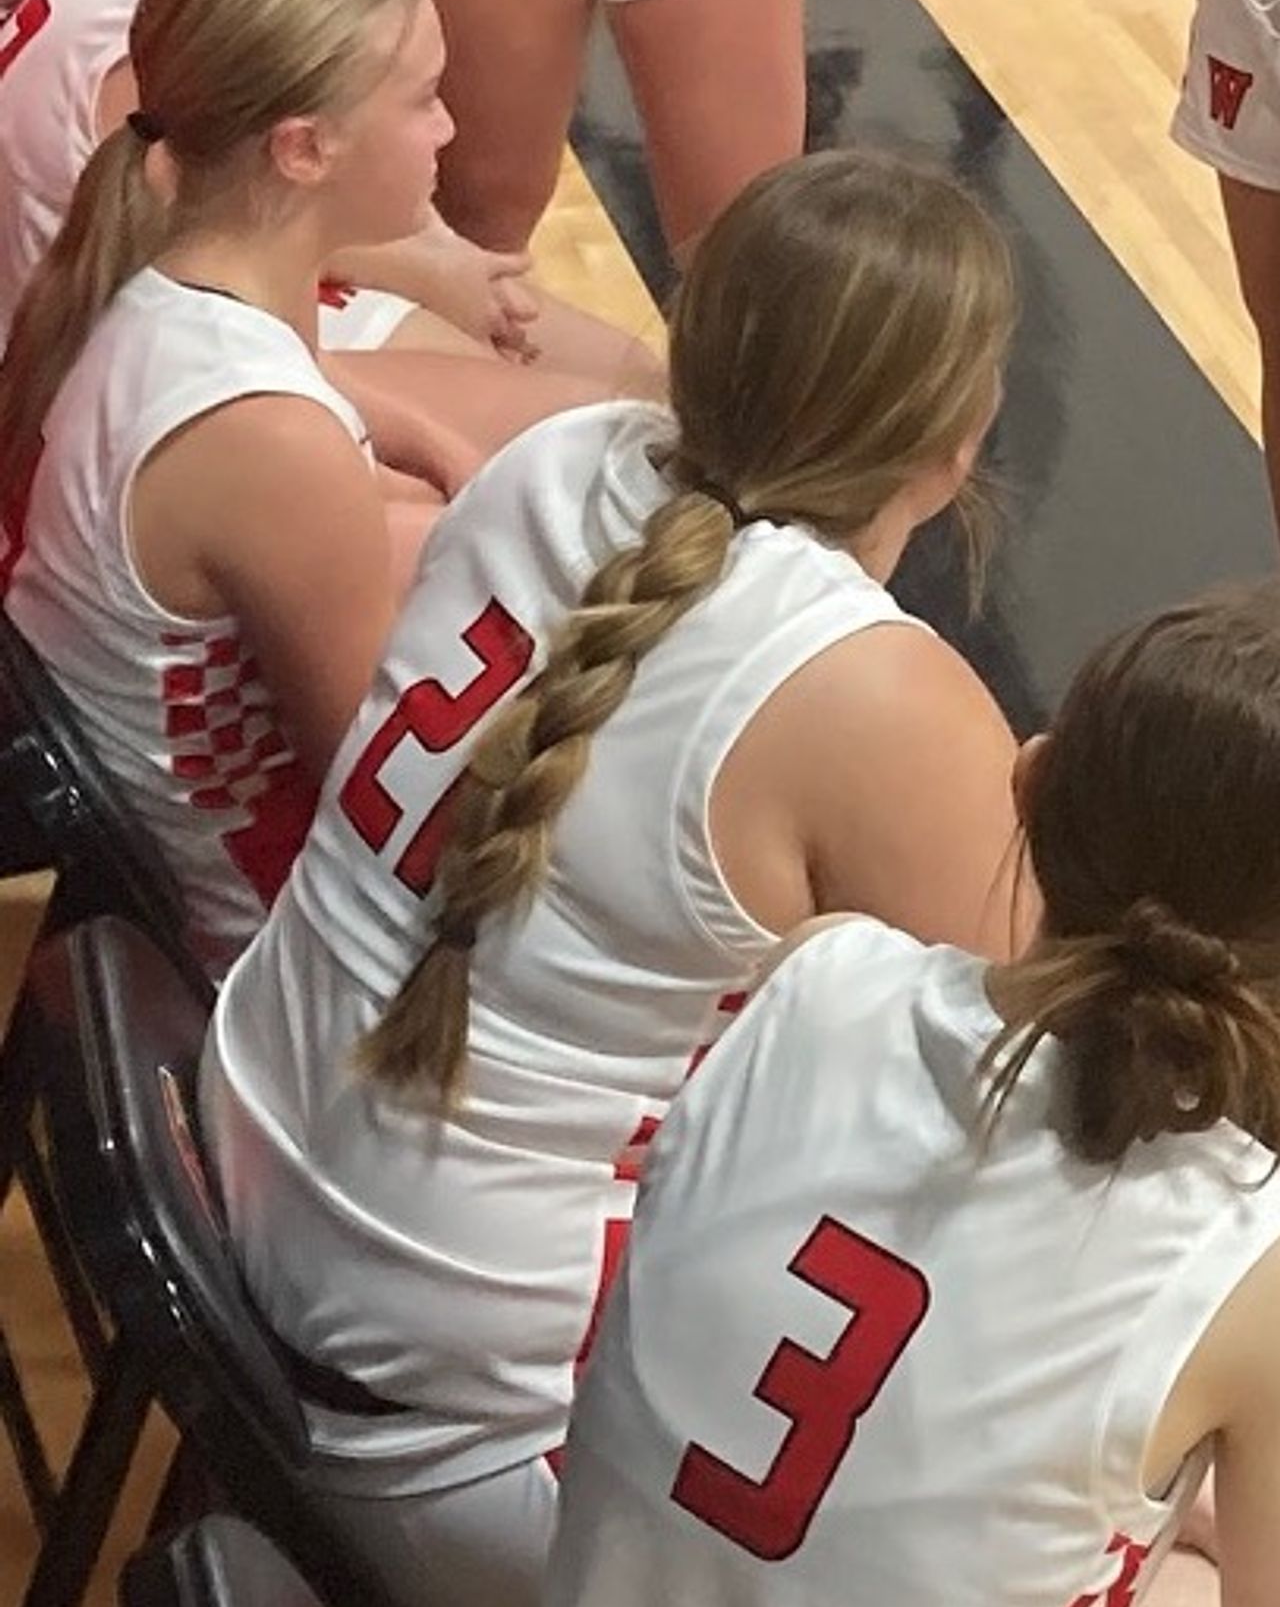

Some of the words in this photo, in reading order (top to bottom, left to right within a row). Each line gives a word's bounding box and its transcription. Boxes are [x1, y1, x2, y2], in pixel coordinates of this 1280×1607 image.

[1206, 54, 1253, 130] W
[340, 597, 536, 900] 2
[669, 1214, 931, 1563] 3
